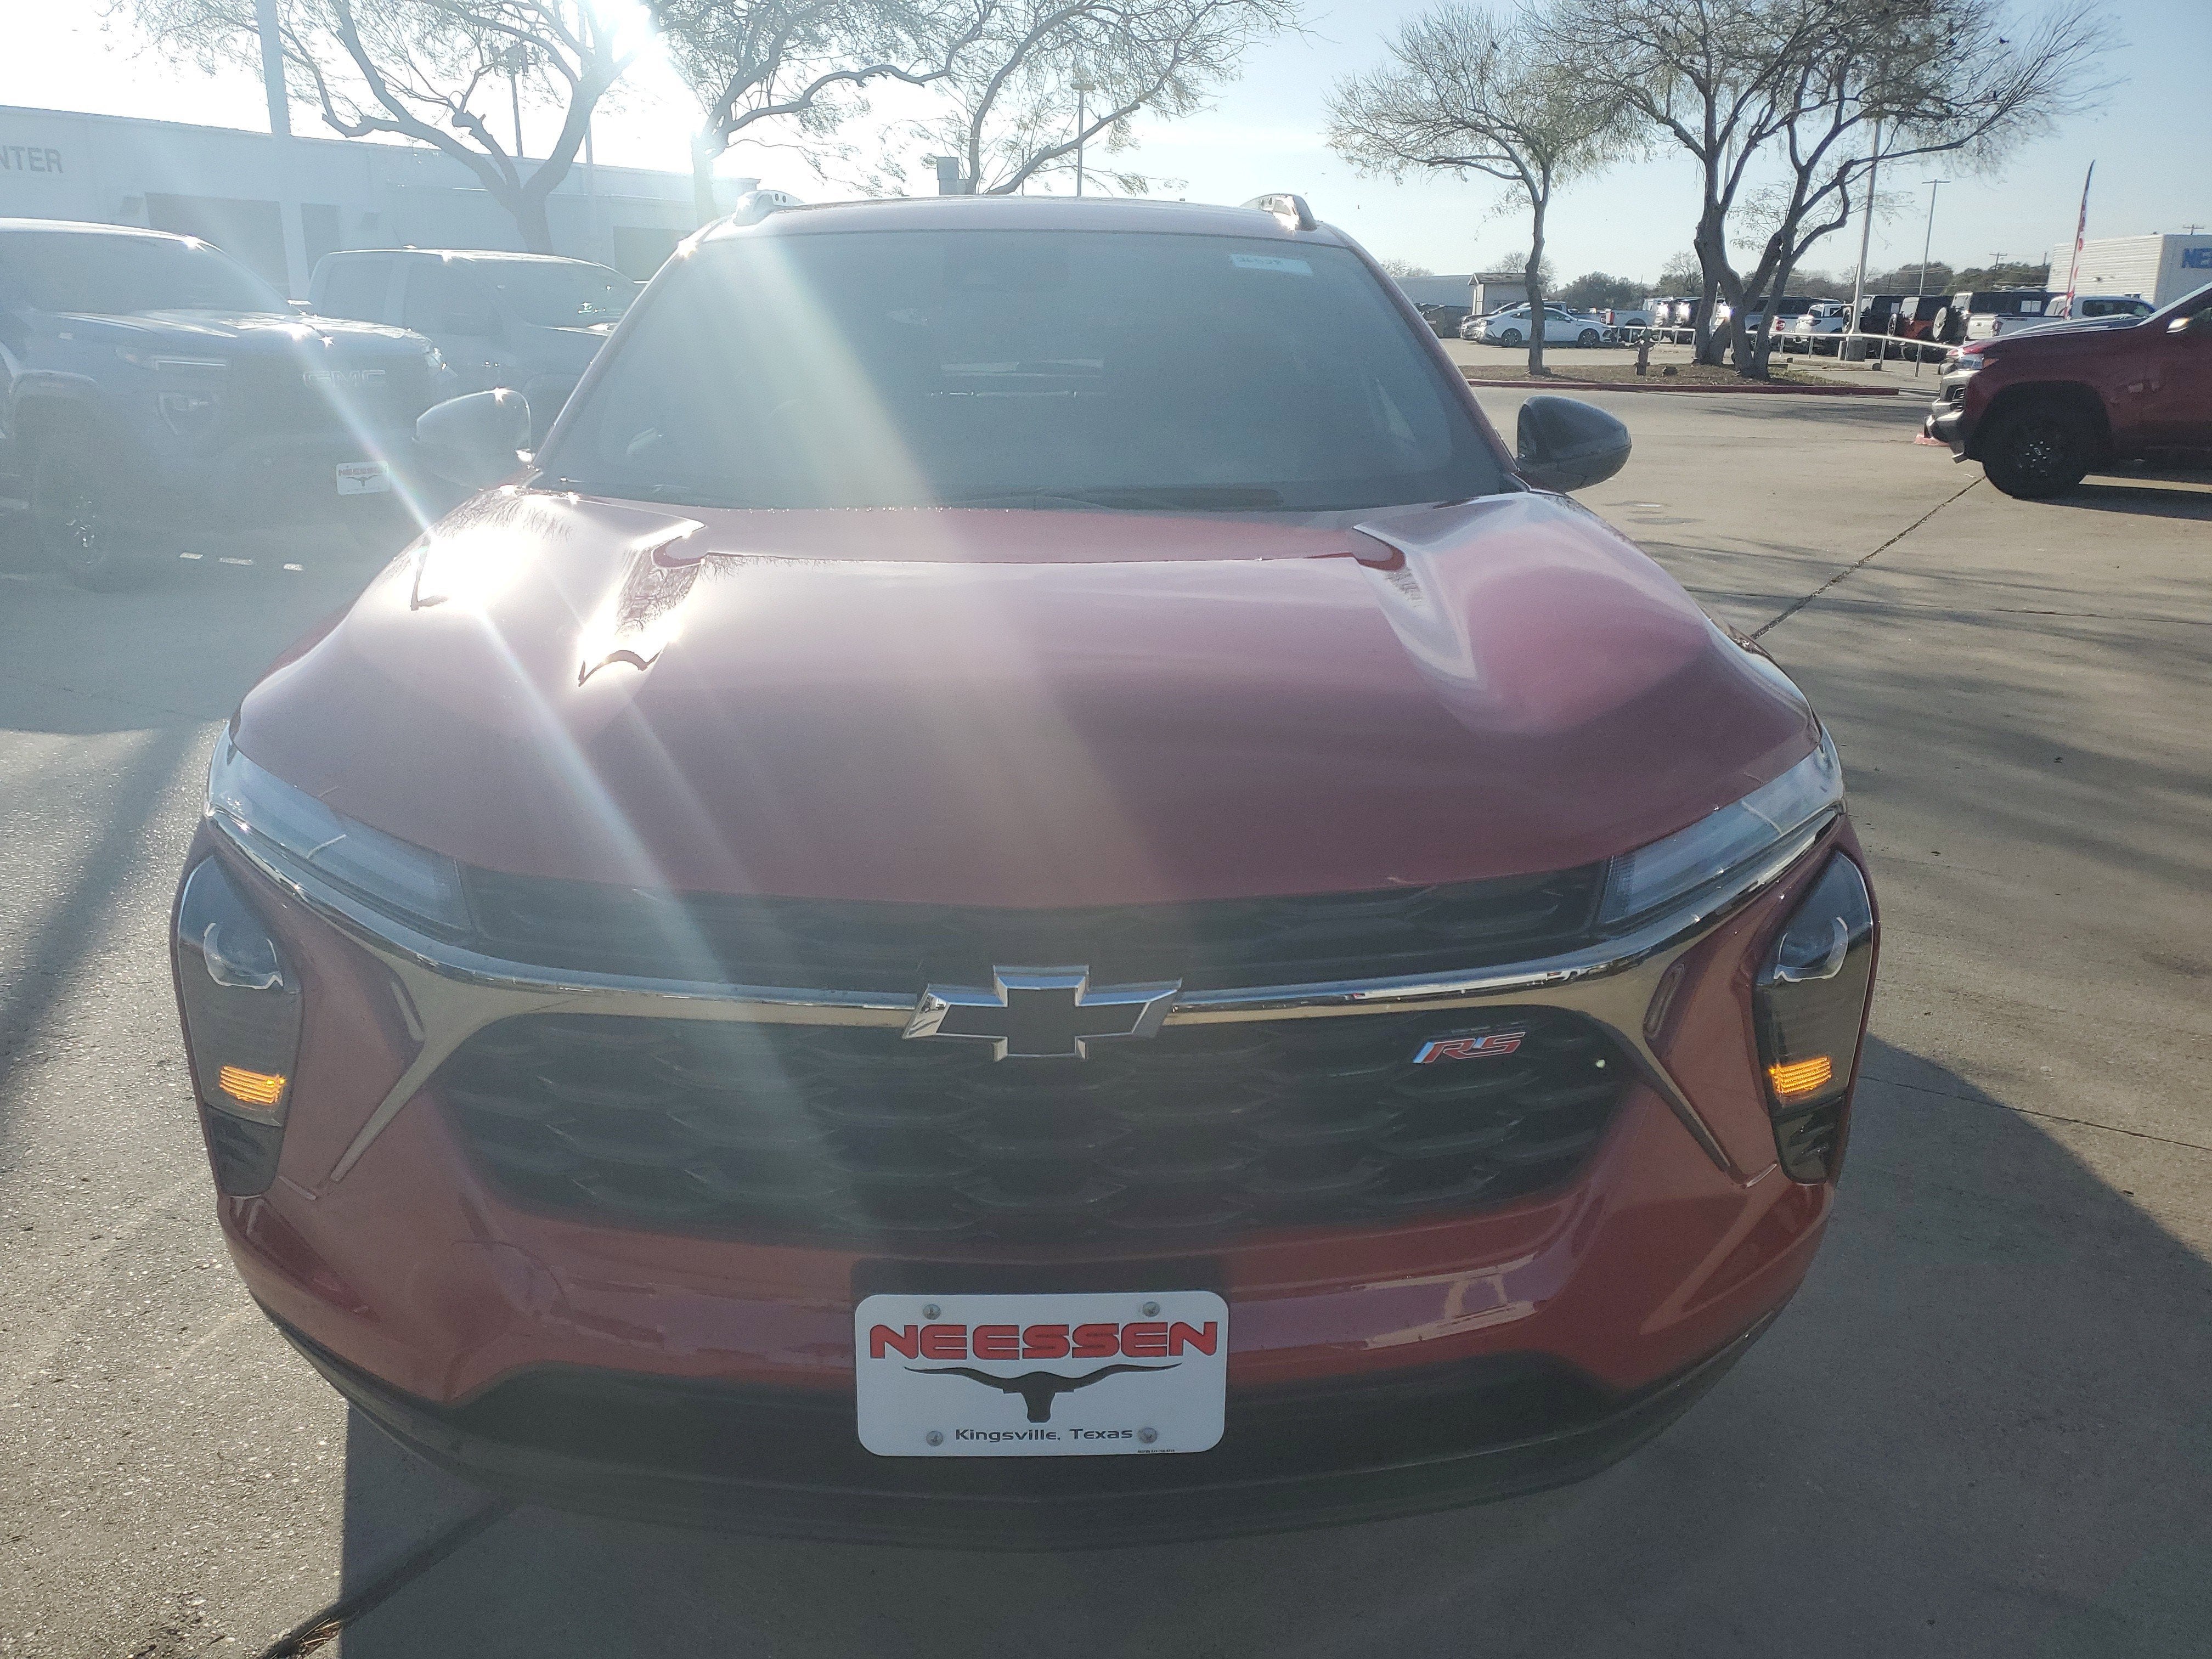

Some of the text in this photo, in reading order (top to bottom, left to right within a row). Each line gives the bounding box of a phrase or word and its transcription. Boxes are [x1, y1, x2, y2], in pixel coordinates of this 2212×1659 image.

[302, 370, 386, 387] GMC
[1412, 1031, 1526, 1064] RS
[869, 1321, 1218, 1360] NEESSEN
[955, 1428, 1133, 1443] Kingsville, Texas
